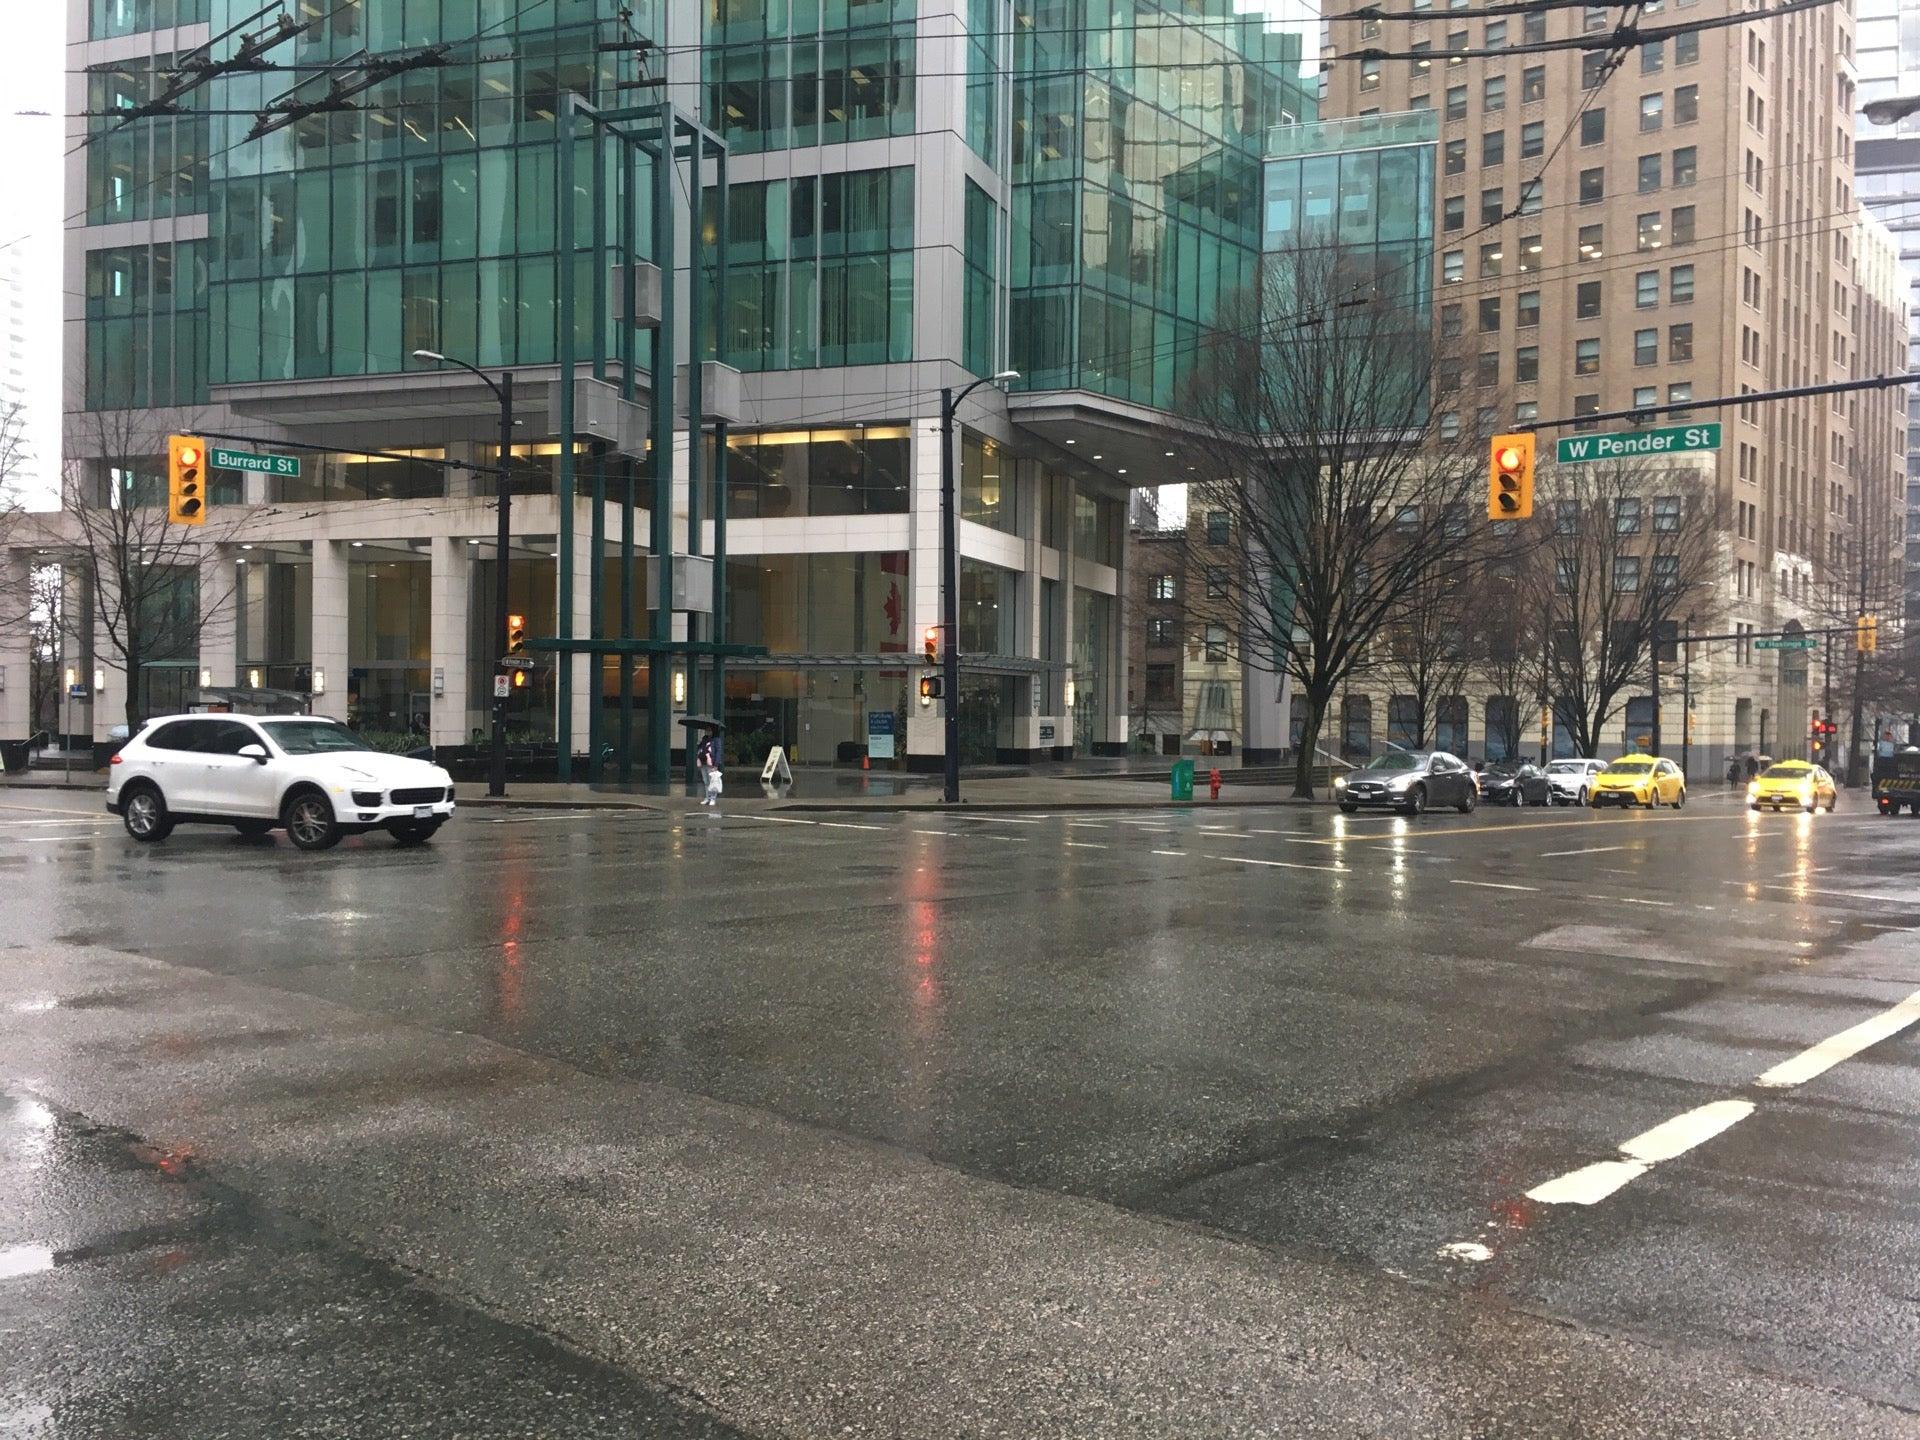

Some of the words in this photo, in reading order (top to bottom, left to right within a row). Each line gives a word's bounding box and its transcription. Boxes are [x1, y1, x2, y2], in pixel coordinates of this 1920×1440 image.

[1568, 440, 1589, 458] W
[1598, 433, 1675, 455] Pender
[1684, 428, 1710, 447] St
[217, 452, 271, 470] Burrard
[277, 459, 293, 473] St
